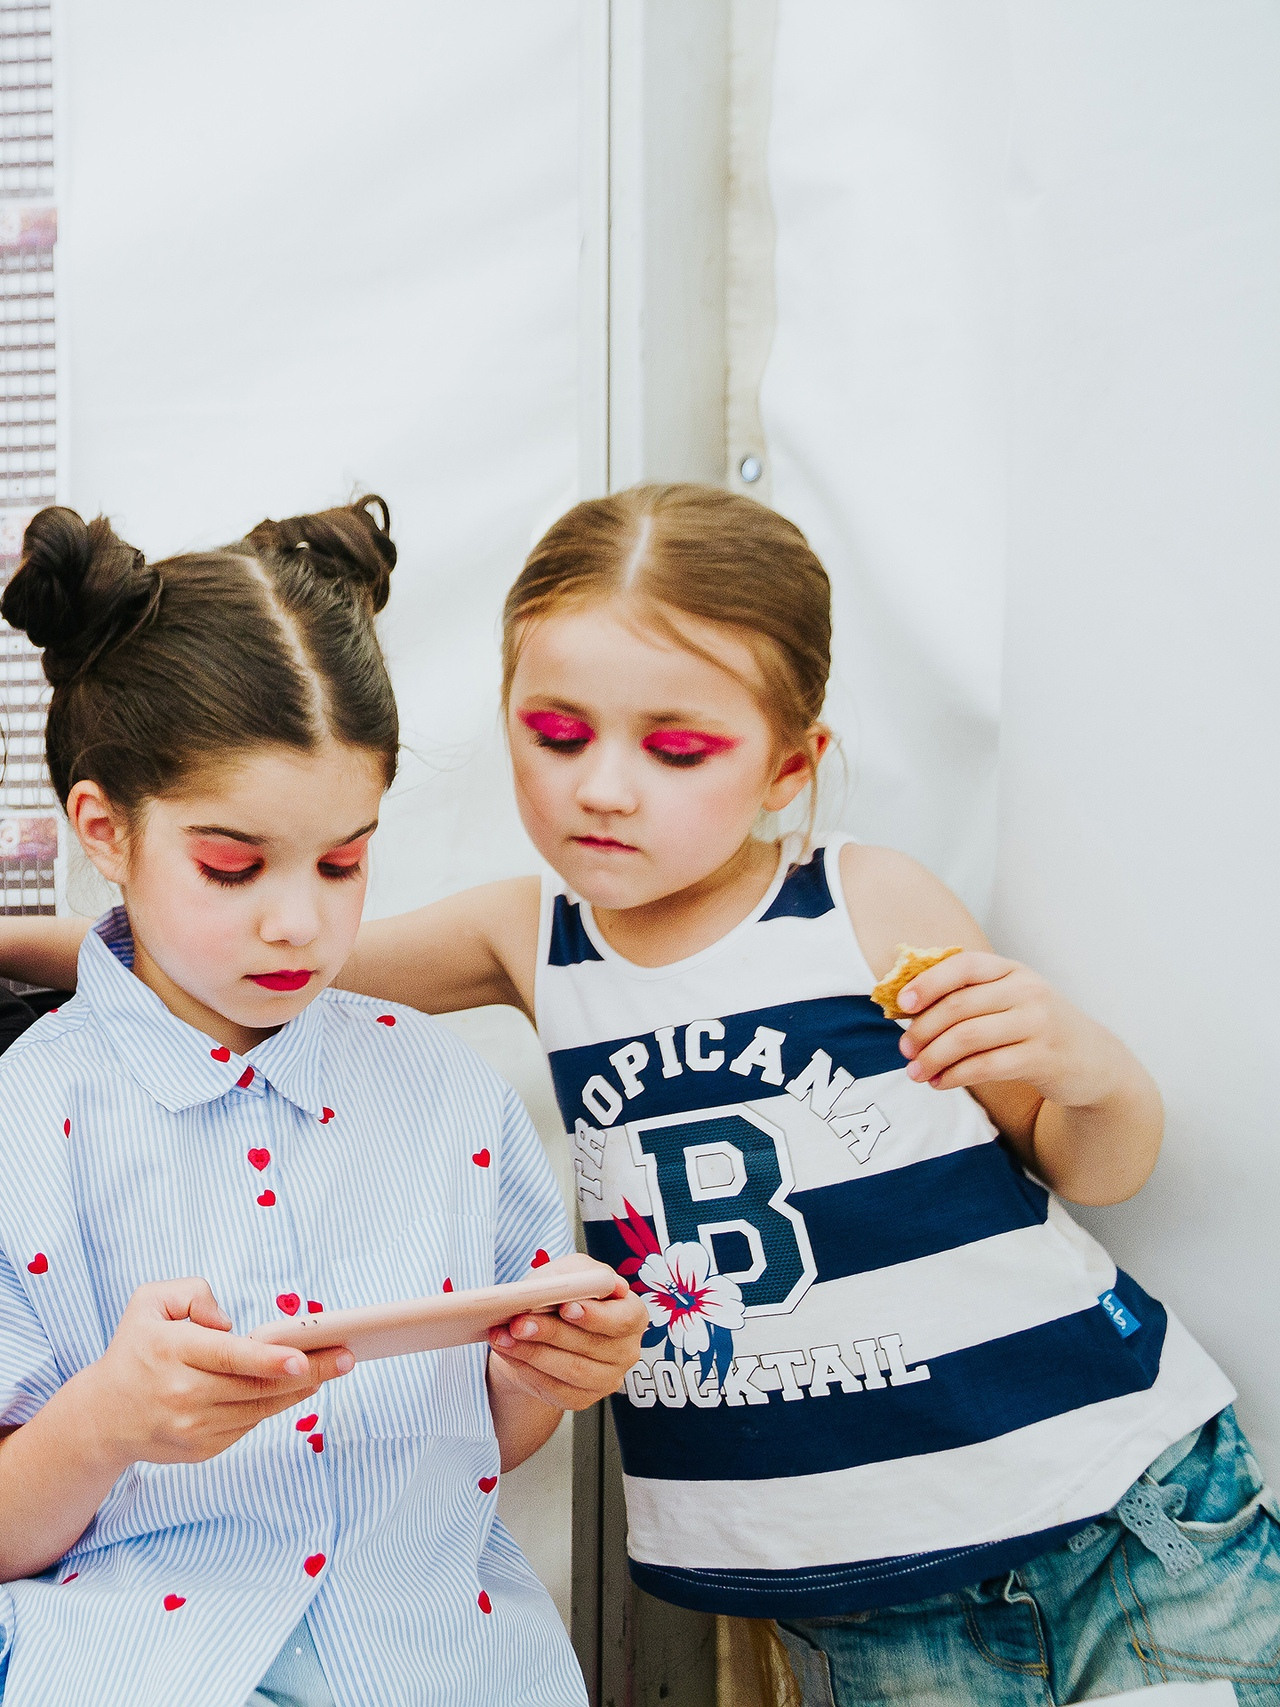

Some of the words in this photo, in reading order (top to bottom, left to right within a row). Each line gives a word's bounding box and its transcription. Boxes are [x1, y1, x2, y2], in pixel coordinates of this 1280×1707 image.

[574, 1019, 891, 1201] TROPICANA
[626, 1101, 818, 1318] B
[623, 1334, 930, 1408] COCKTAIL
